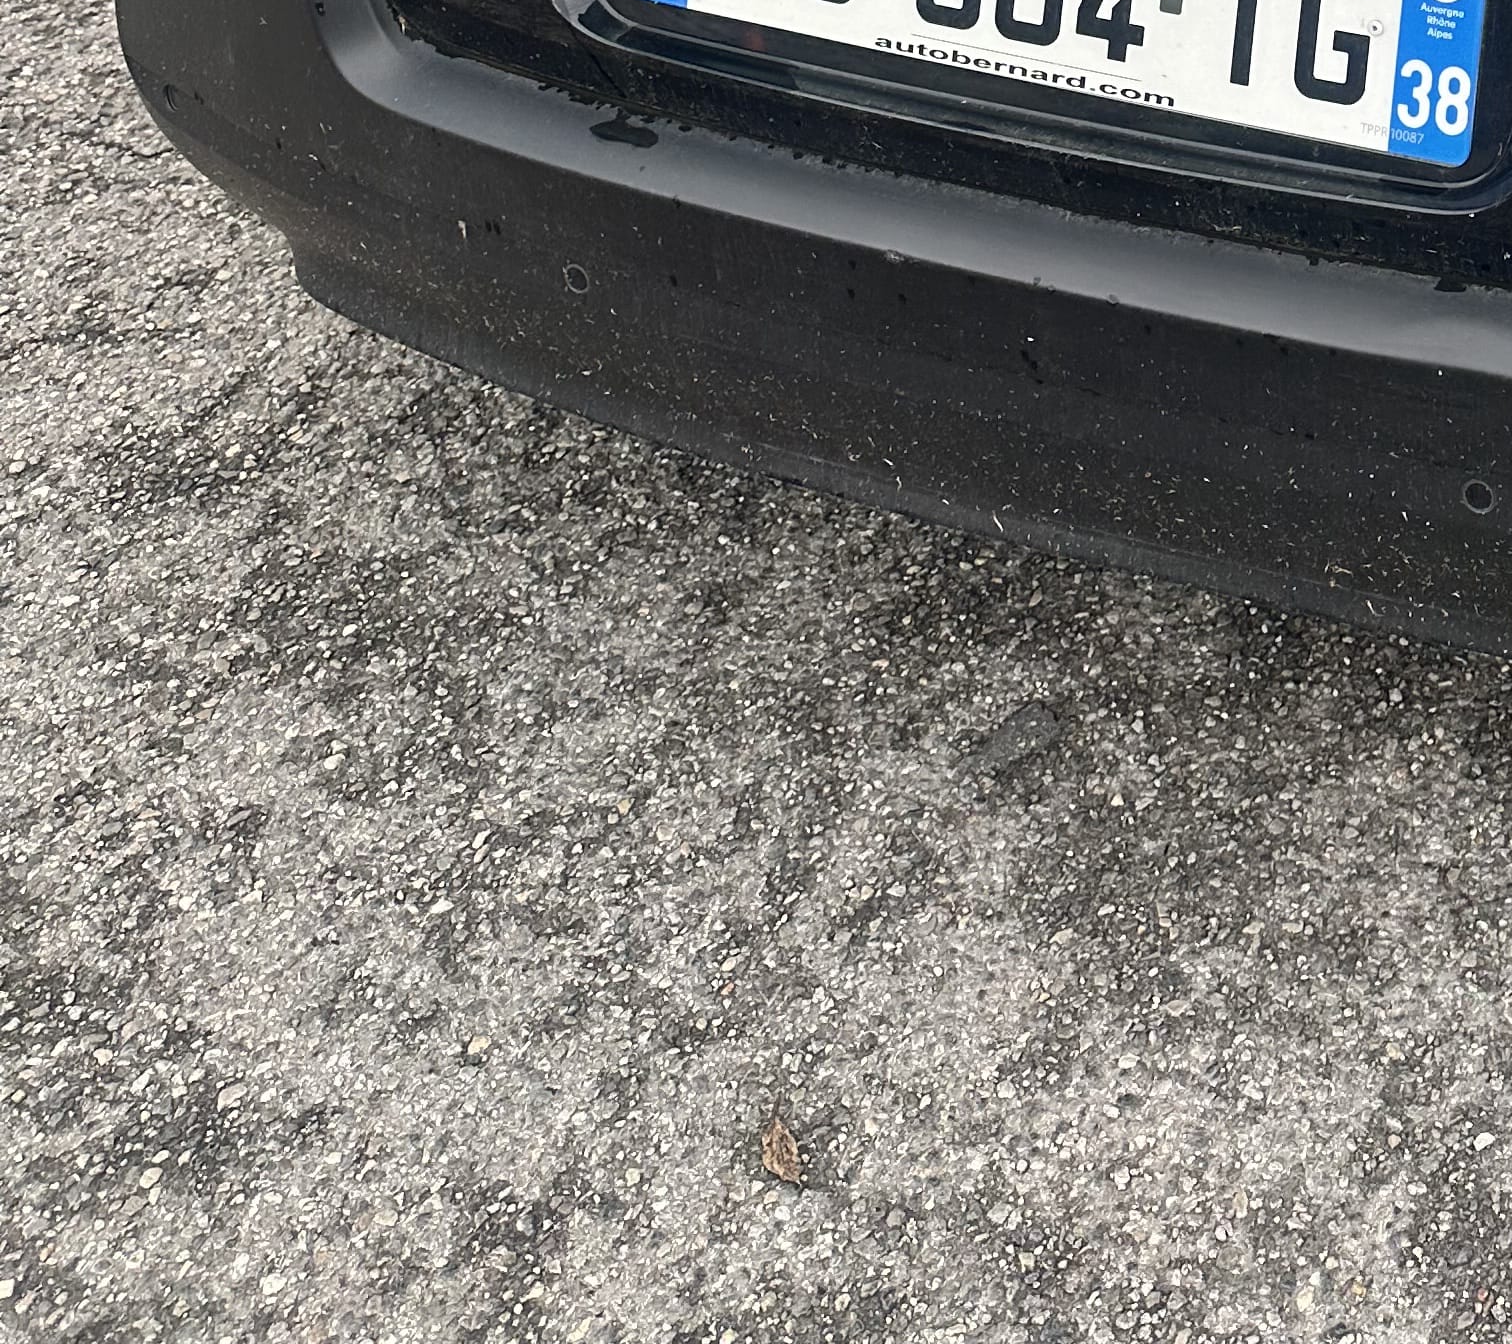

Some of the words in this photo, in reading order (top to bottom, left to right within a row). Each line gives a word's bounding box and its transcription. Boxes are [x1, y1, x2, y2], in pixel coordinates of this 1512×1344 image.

[1419, 2, 1465, 19] Auvergne
[1426, 15, 1457, 29] Rhône
[1427, 27, 1453, 40] Alpes
[874, 36, 1175, 108] autobernard.com
[1396, 58, 1471, 137] 38
